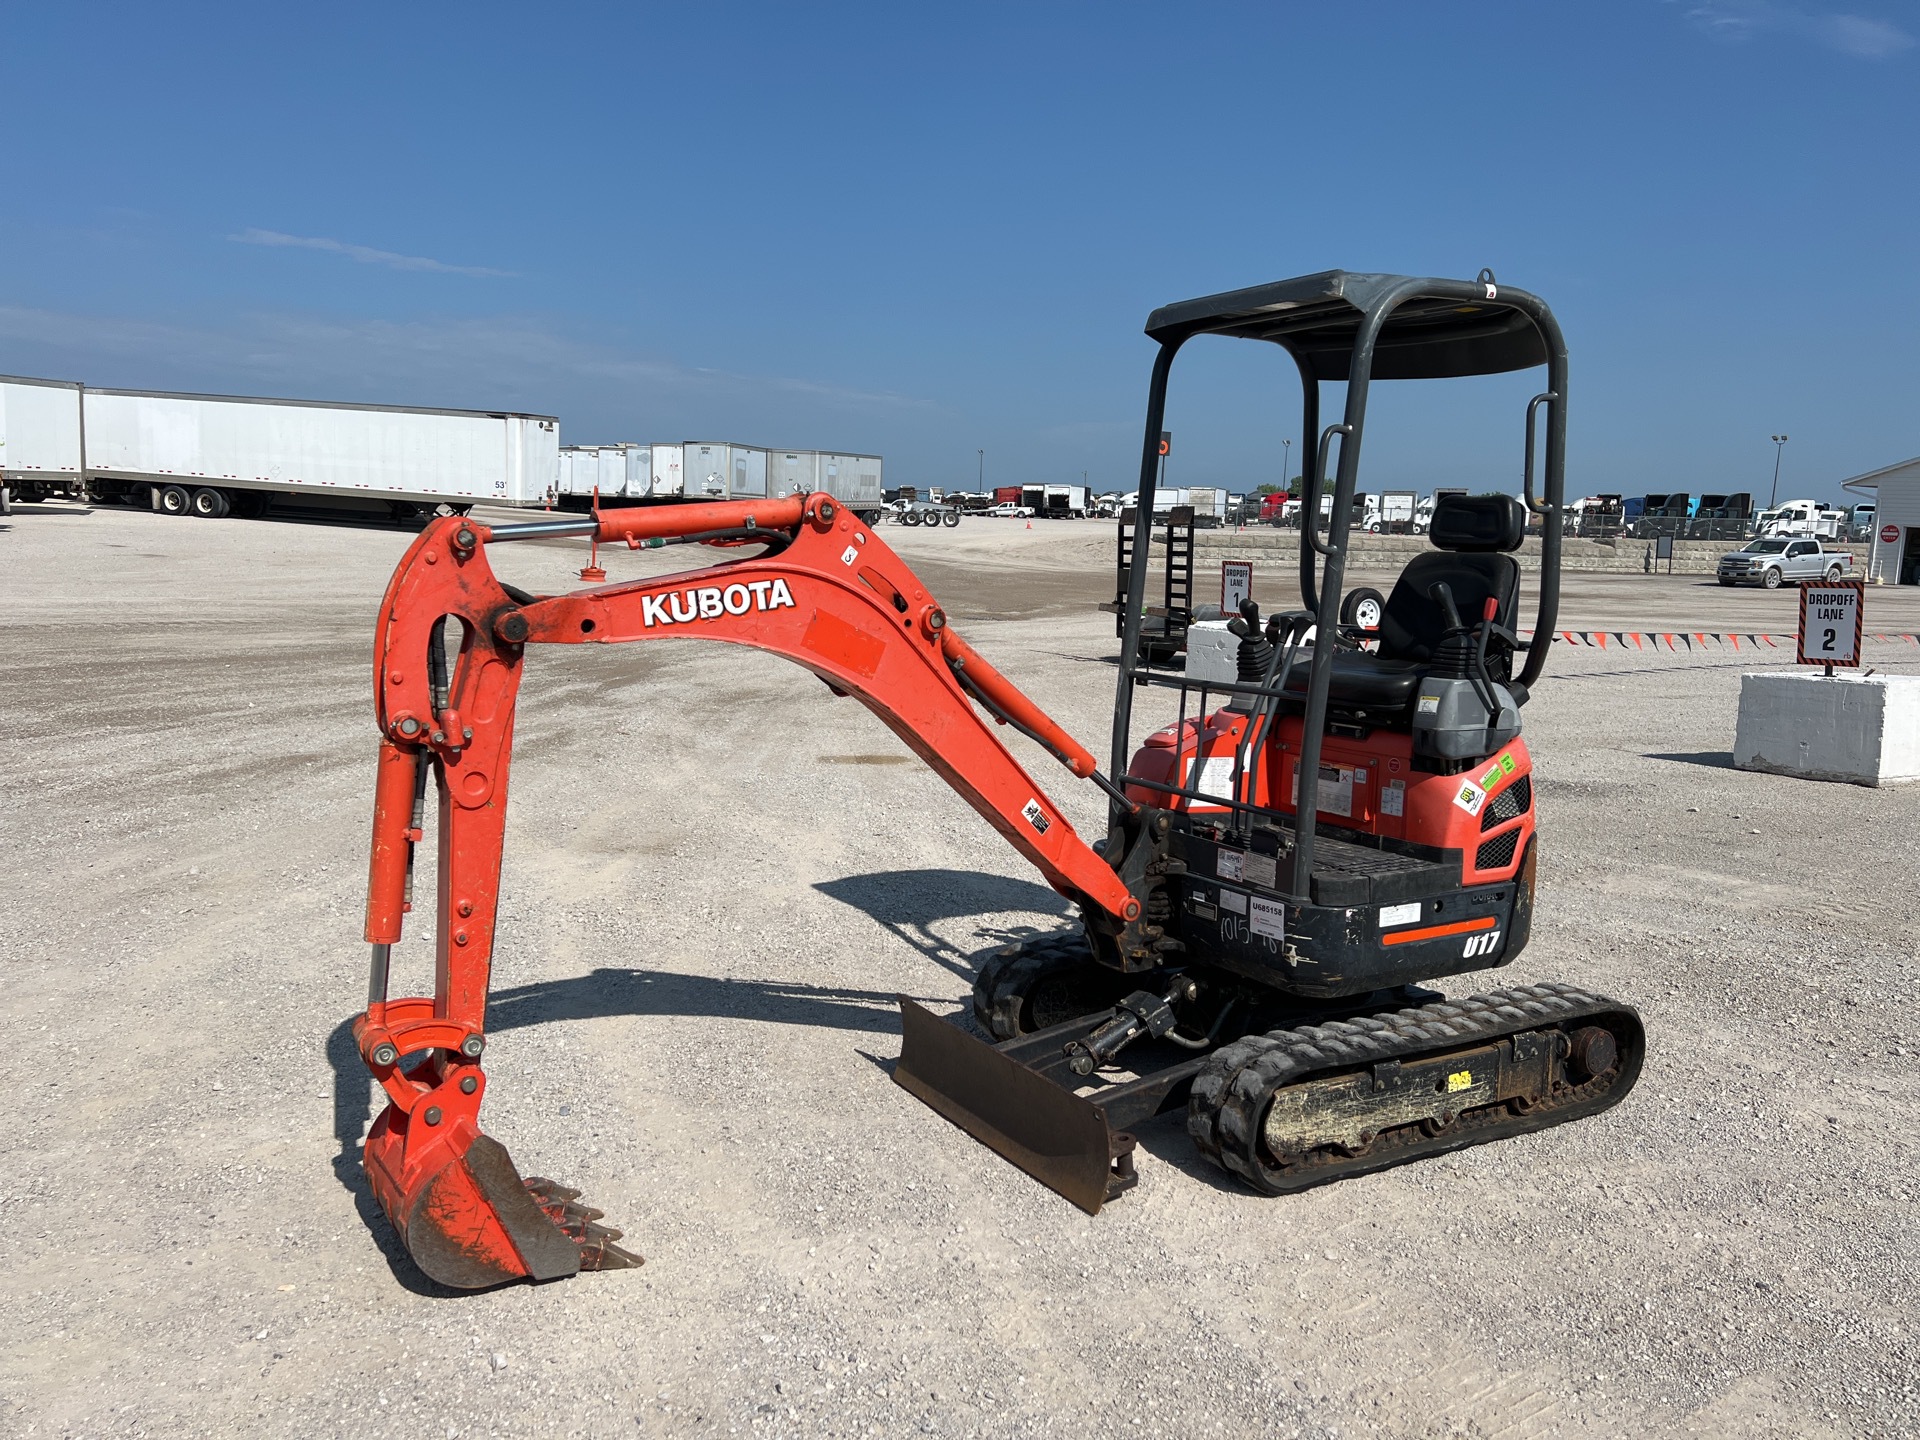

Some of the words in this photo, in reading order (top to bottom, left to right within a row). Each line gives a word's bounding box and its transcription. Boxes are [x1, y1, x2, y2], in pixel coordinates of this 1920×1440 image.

[1226, 568, 1248, 577] DROPOFF
[1230, 578, 1243, 587] LANE
[641, 579, 795, 627] KUBOTA
[1233, 592, 1239, 608] 1
[1809, 594, 1855, 606] DROPOFF
[1817, 608, 1844, 620] LANE
[1822, 628, 1836, 651] 2
[1461, 788, 1473, 801] 811
[1252, 902, 1283, 916] U685158
[1462, 930, 1501, 959] U17
